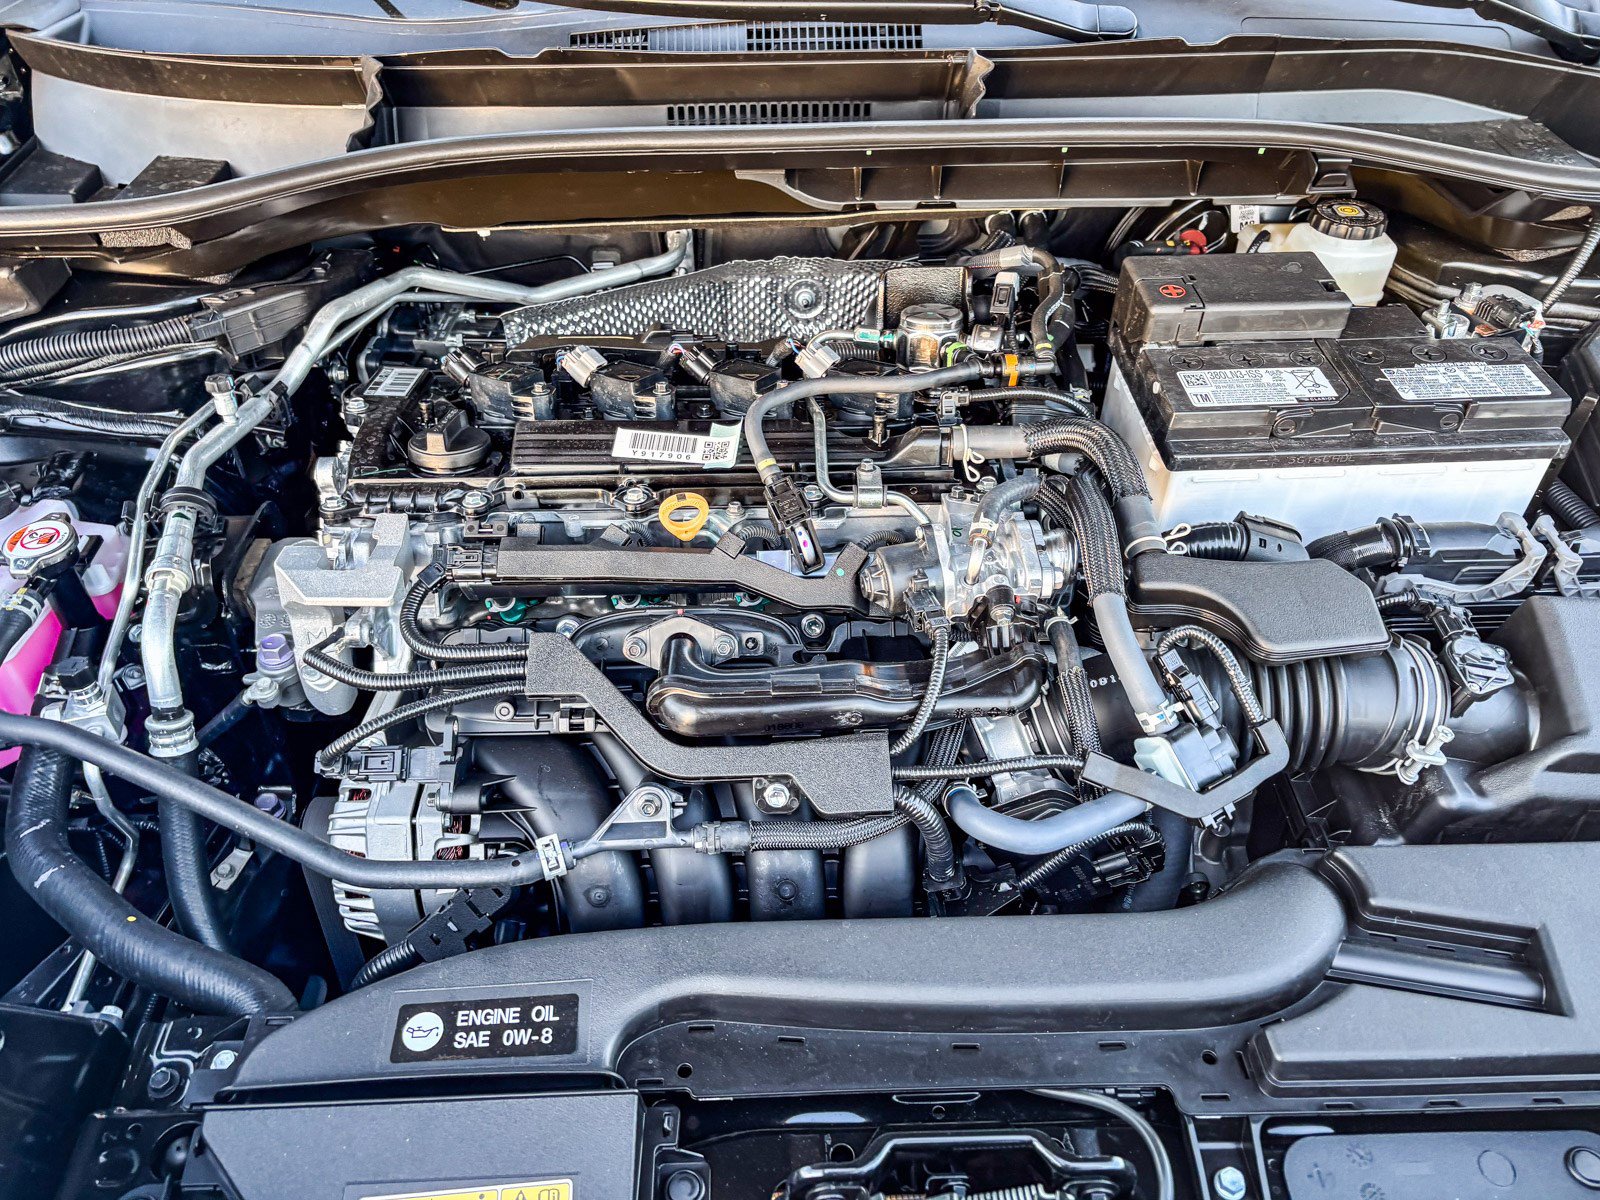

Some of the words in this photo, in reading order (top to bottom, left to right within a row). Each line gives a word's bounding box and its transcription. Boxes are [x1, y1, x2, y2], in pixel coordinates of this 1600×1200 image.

[1192, 393, 1211, 403] TM
[632, 449, 691, 460] Y917906
[456, 1007, 521, 1027] ENGINE
[531, 1005, 560, 1023] OIL
[453, 1030, 491, 1049] SAE
[502, 1027, 553, 1046] 0W-8
